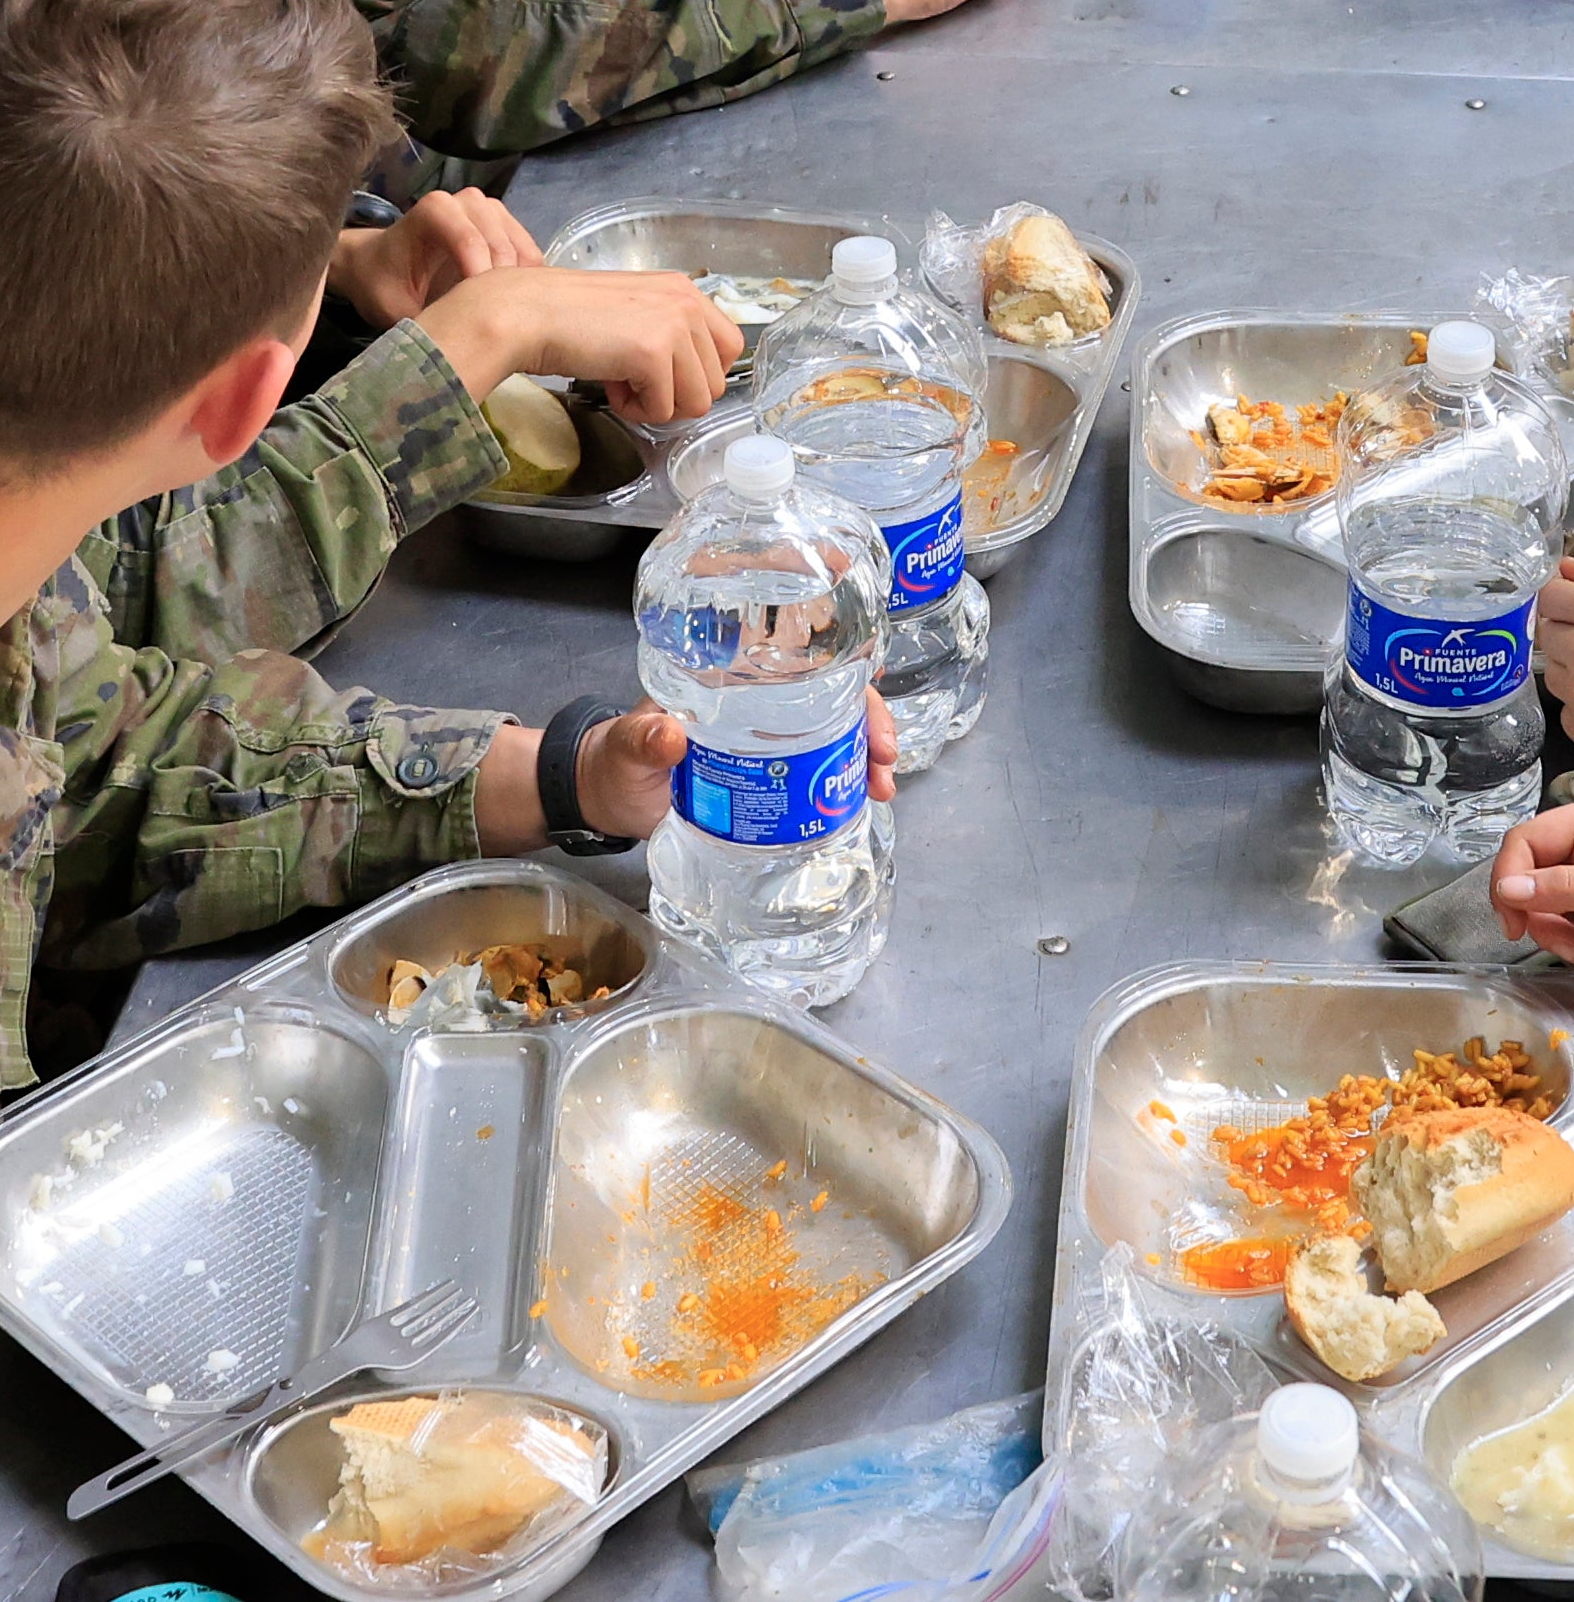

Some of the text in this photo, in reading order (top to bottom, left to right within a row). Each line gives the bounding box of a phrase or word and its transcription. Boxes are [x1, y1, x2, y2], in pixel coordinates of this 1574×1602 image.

[888, 592, 908, 610] ,5L
[1400, 647, 1506, 674] Primavera
[1435, 648, 1477, 656] FUENTE
[1375, 673, 1398, 695] 1,5L
[799, 818, 826, 838] 1,5L
